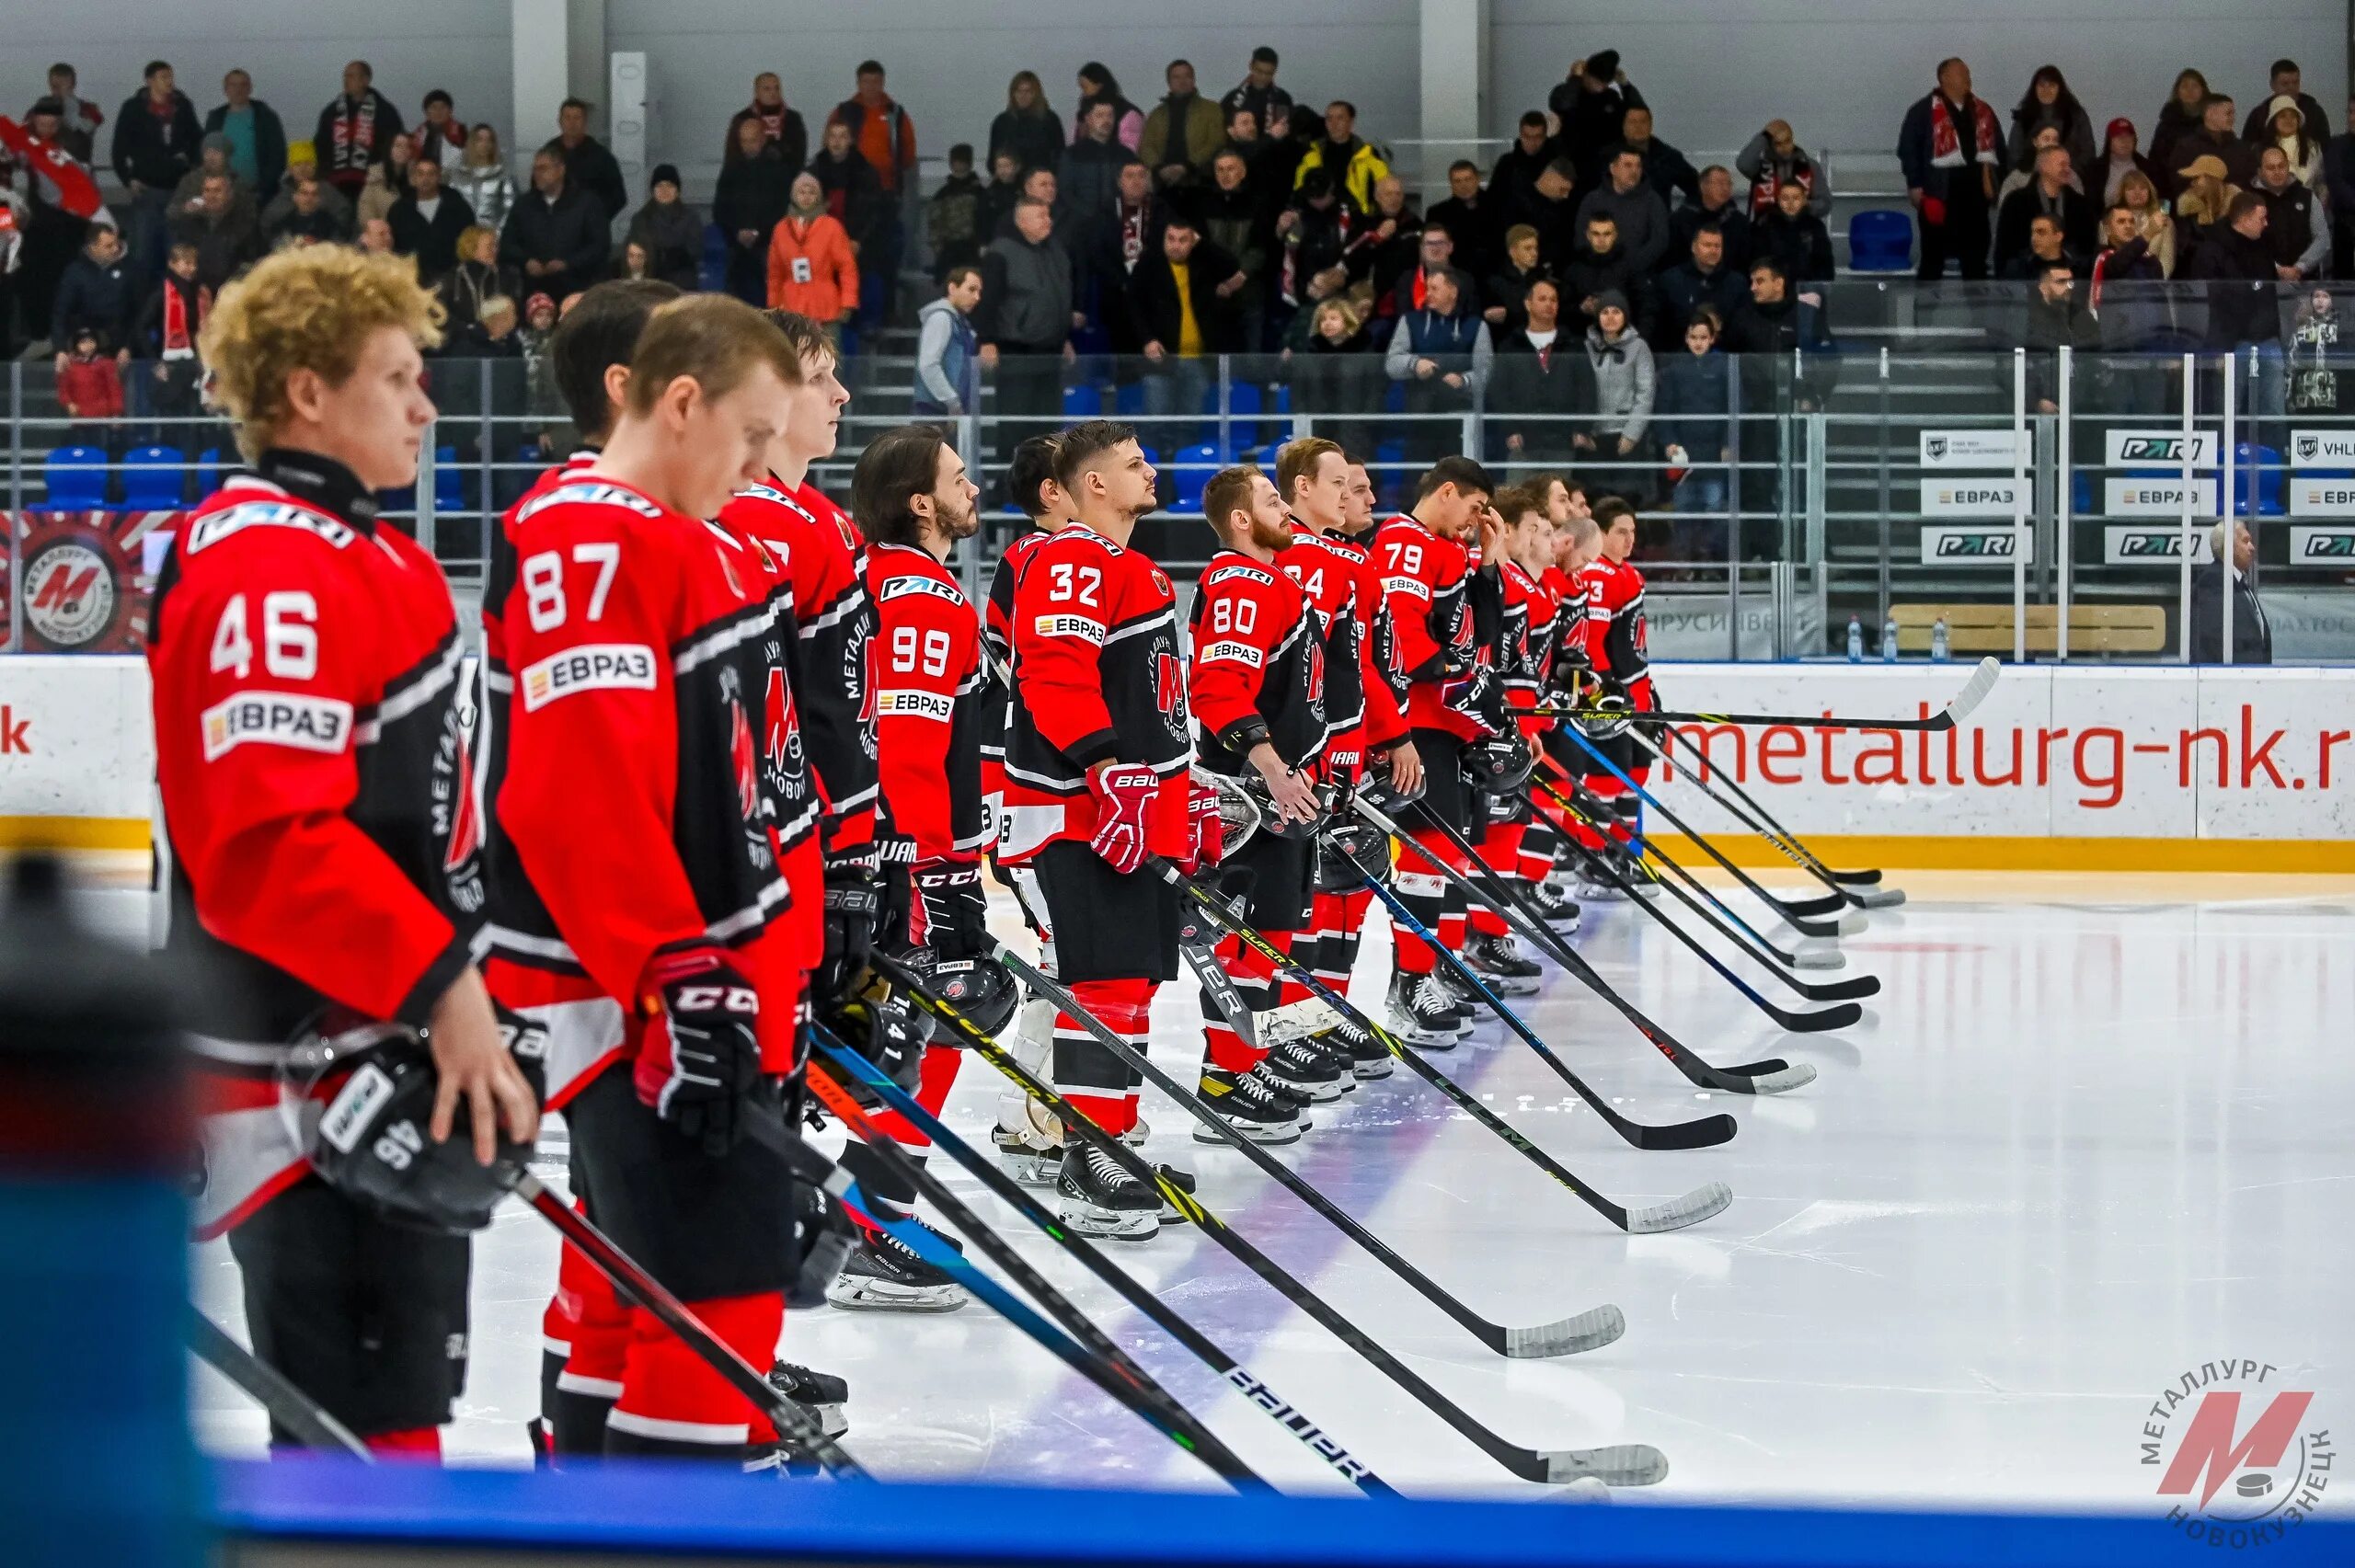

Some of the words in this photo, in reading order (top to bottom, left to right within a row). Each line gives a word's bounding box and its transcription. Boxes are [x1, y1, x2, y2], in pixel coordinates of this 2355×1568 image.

[1955, 490, 2014, 504] ЕВРАЗ
[1384, 542, 1424, 575] 79
[1938, 535, 2015, 555] PARI
[522, 542, 621, 635] 87
[882, 578, 962, 604] PARI
[1049, 563, 1102, 609] 32
[1211, 567, 1273, 586] PARI
[1389, 579, 1427, 597] ЕВРАЗ
[1056, 618, 1104, 642] ЕВРАЗ
[1213, 598, 1258, 635] 80
[210, 590, 319, 681] 46
[891, 626, 950, 678] 99
[549, 648, 650, 689] ЕВРАЗ
[1213, 644, 1260, 664] ЕВРАЗ
[895, 694, 950, 716] ЕВРАЗ
[227, 703, 341, 741] ЕВРАЗ
[1239, 928, 1287, 965] SUPER
